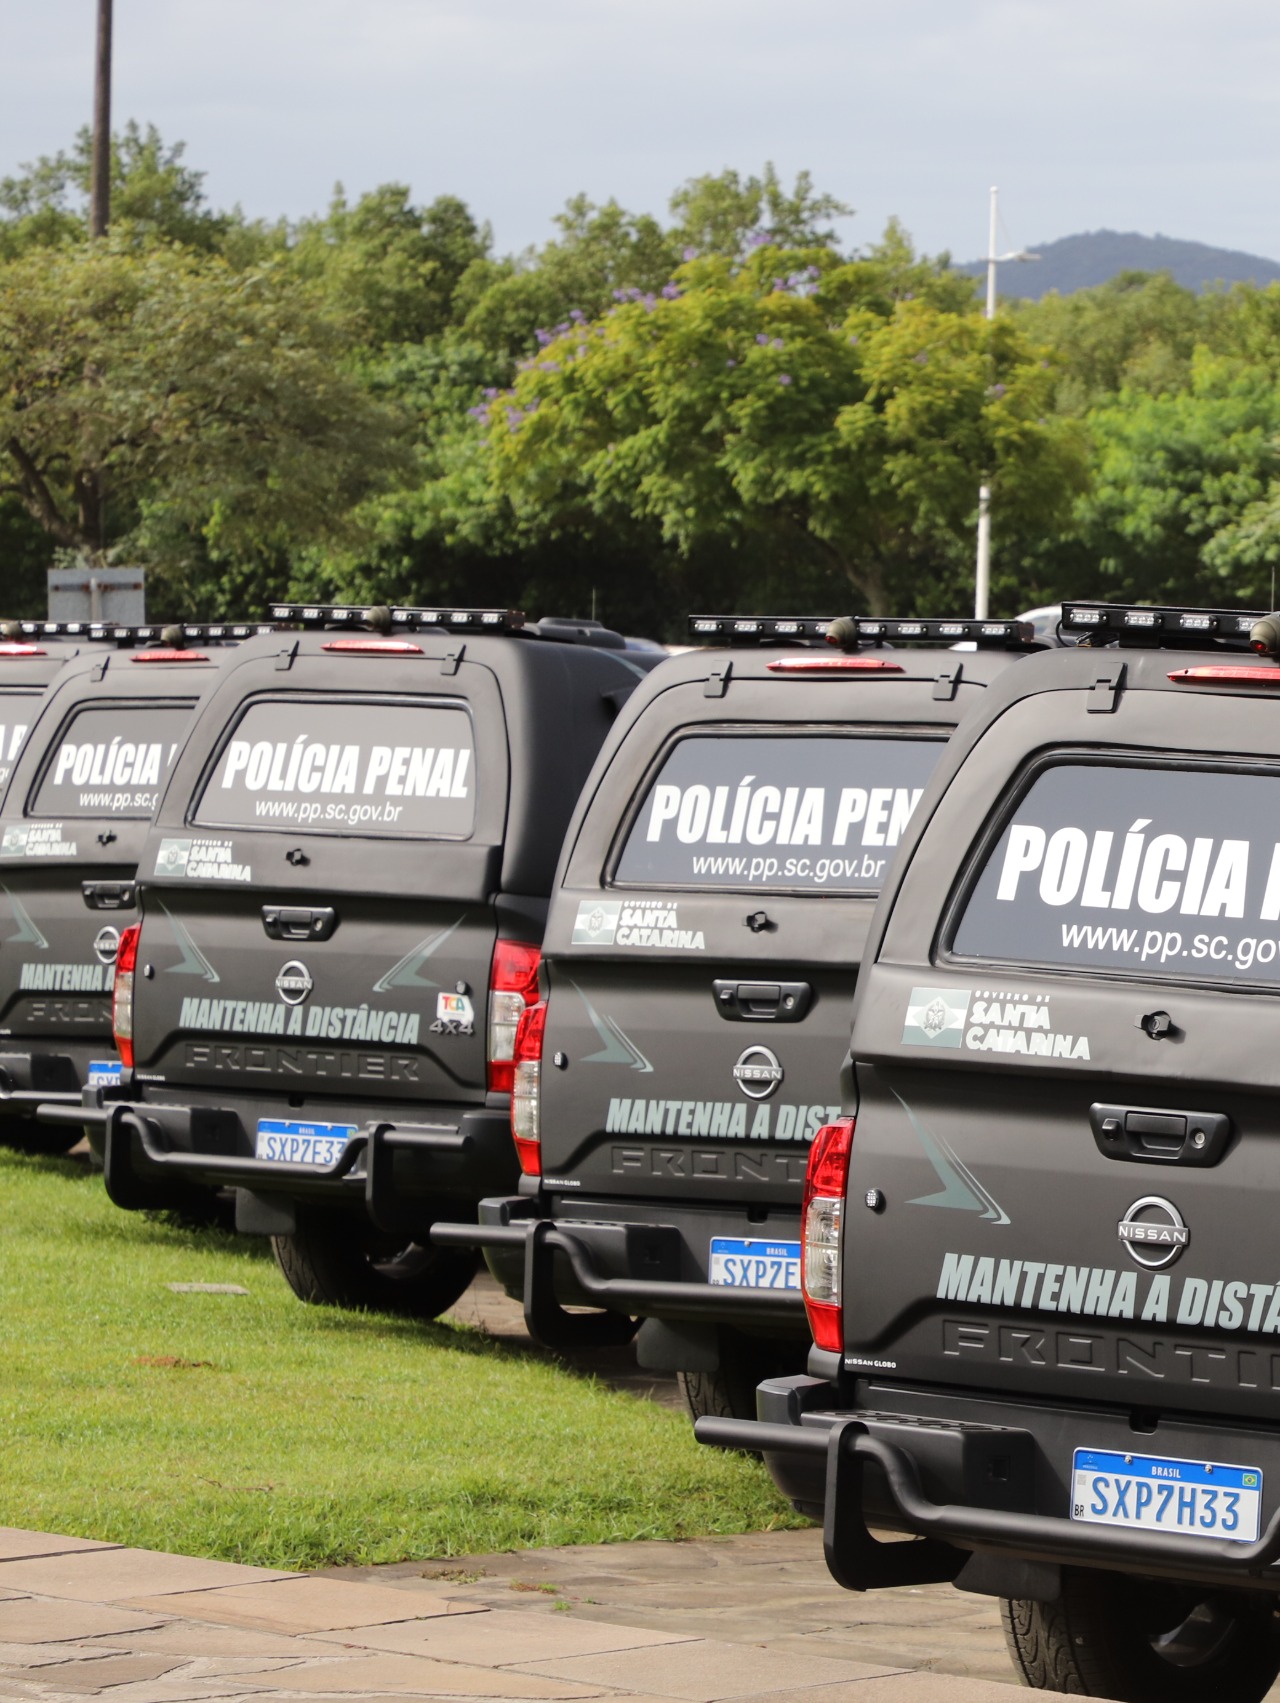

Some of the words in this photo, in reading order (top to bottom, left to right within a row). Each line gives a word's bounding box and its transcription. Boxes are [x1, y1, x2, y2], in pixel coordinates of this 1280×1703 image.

[53, 736, 162, 786] POLÍCIA
[221, 734, 360, 794] POLÍCIA
[362, 746, 470, 798] PENAL
[255, 801, 403, 825] www.pp.sc.gov.br
[646, 775, 825, 845] POLÍCIA
[692, 854, 886, 883] www.pp.sc.gov.br
[996, 818, 1250, 919] POLÍCIA
[619, 908, 677, 928] SANTA
[616, 926, 705, 949] CATARINA
[20, 963, 103, 991] MANTENHA
[442, 995, 465, 1011] TCA
[969, 1001, 1050, 1029] SANTA
[179, 997, 286, 1034] MANTENHA
[286, 1005, 303, 1036] A
[305, 1003, 420, 1045] DISTÂNCIA
[965, 1026, 1090, 1060] CATARINA
[184, 1043, 419, 1081] FRONTIER
[733, 1068, 781, 1080] NISSAN
[605, 1098, 747, 1139] MANTENHA
[750, 1104, 770, 1139] A
[1119, 1225, 1186, 1243] NISSAN
[936, 1252, 1138, 1320] MANTENHA
[1141, 1274, 1171, 1322] A
[844, 1358, 873, 1366] NISSAN
[874, 1360, 896, 1369] GLOBO
[1151, 1466, 1181, 1479] BRASIL
[1074, 1504, 1084, 1517] BR
[1090, 1476, 1240, 1531] SXP7H33
